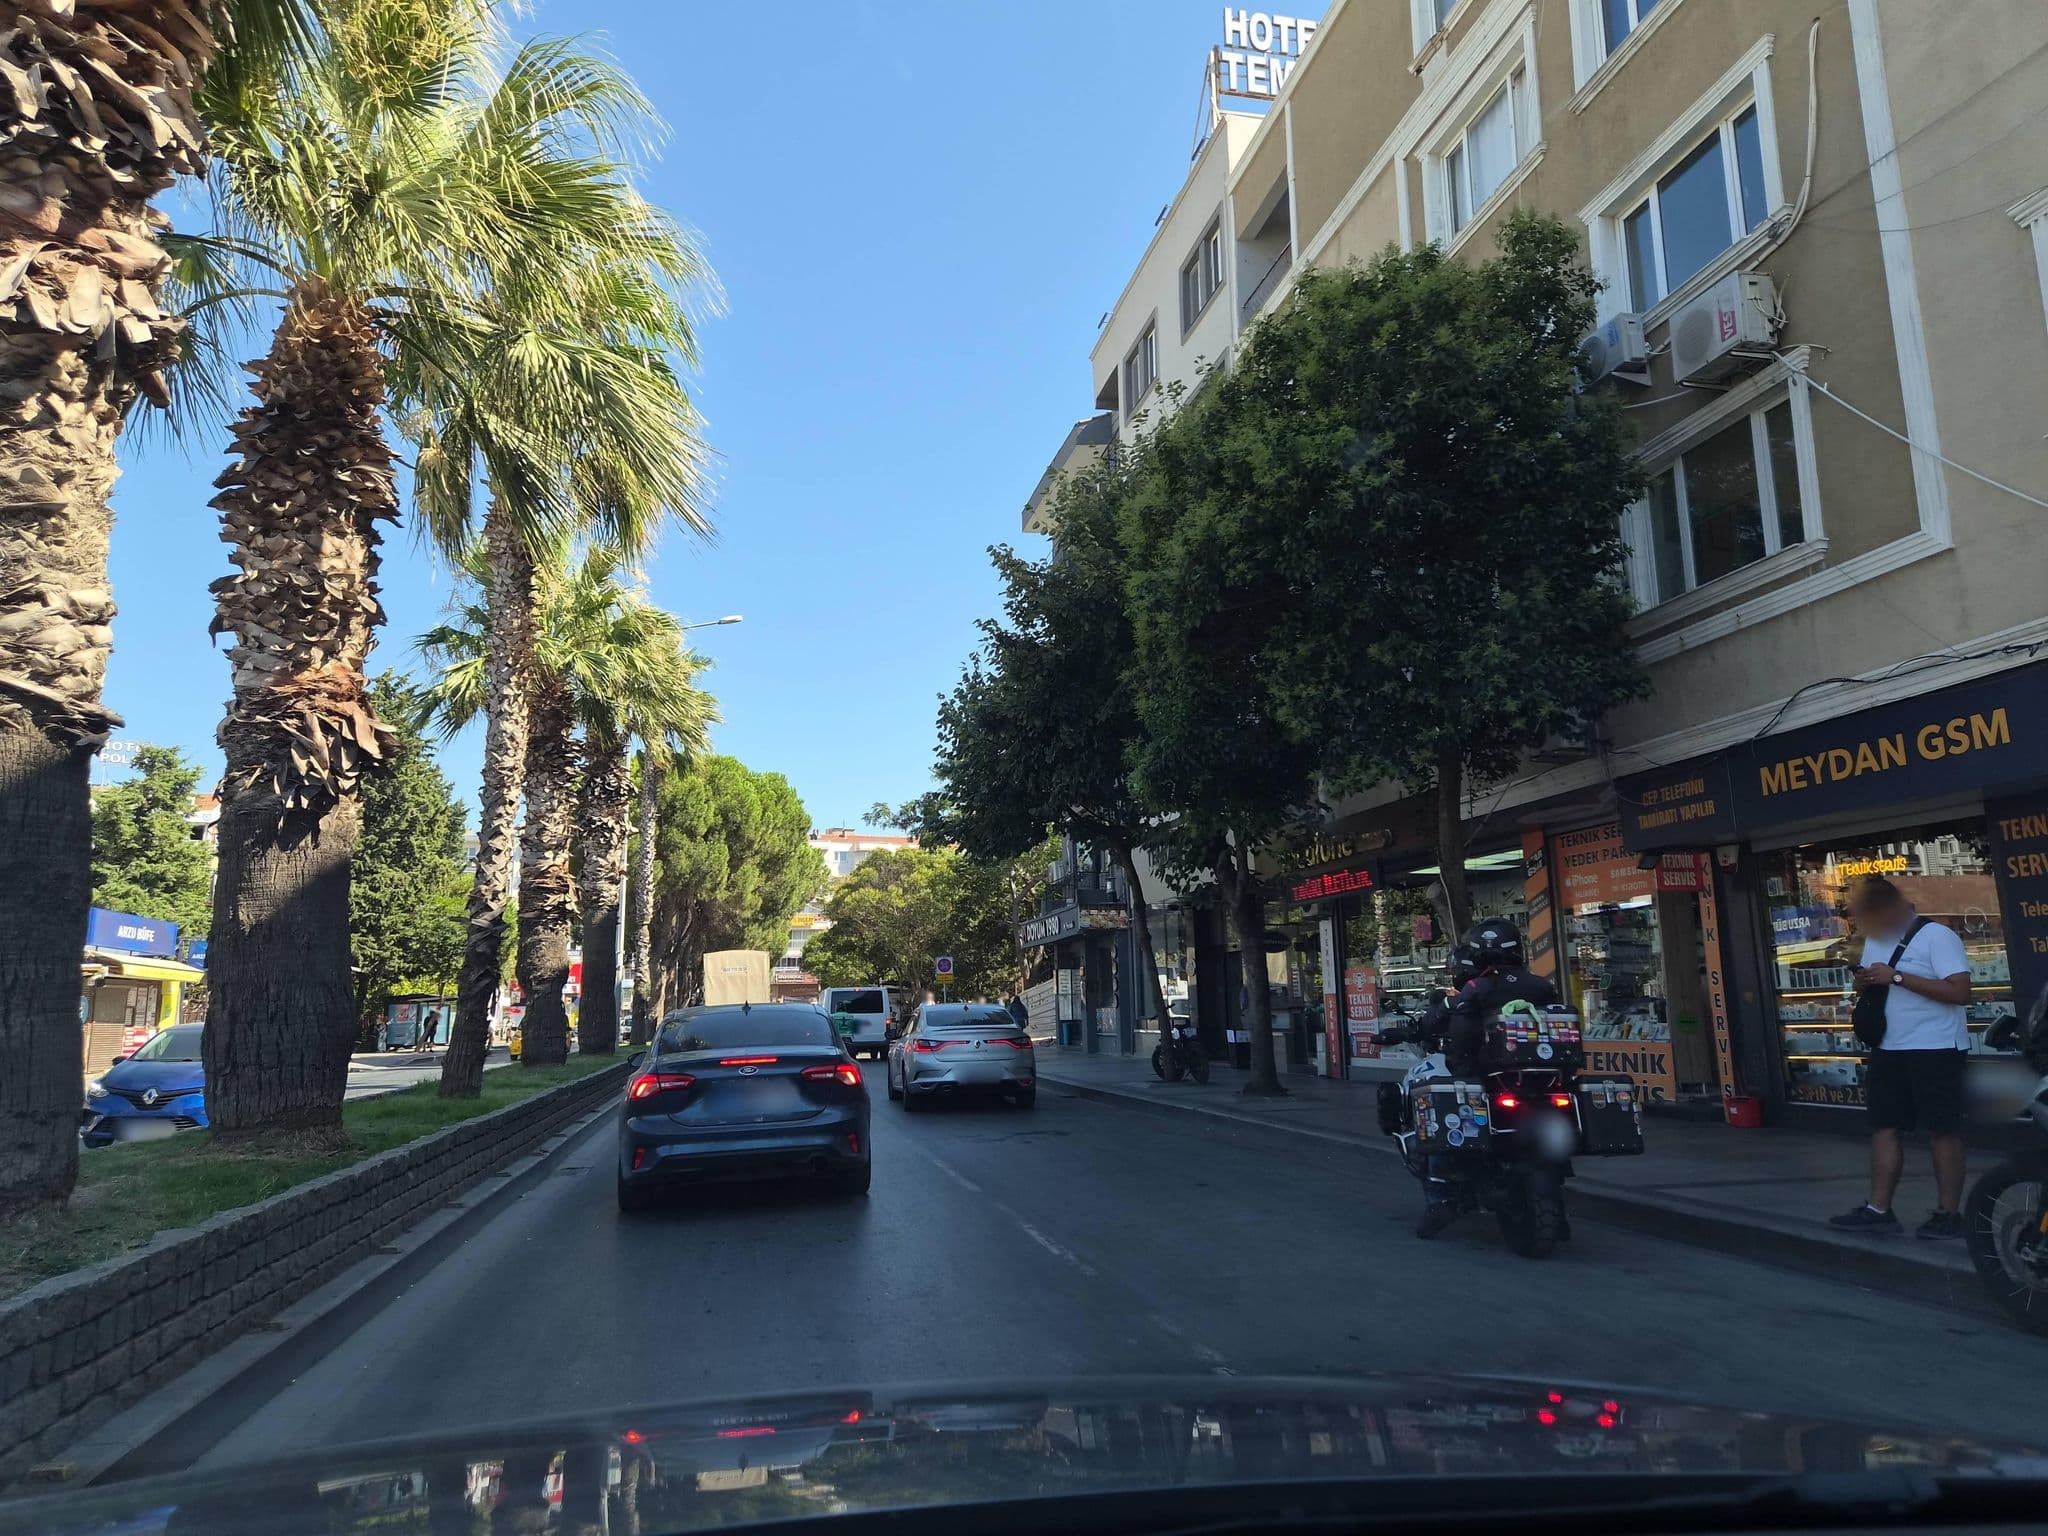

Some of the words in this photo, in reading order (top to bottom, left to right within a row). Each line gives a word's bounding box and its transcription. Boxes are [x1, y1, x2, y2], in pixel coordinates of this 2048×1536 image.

[1759, 732, 1908, 796] MEYDAN
[1916, 707, 2011, 761] GSM
[1660, 778, 1704, 801] TELEFONU
[1680, 799, 1716, 821] YAPILIR
[1563, 850, 1600, 868] YEDEK
[1662, 852, 1695, 869] TEKNİK
[1663, 870, 1697, 886] SERVİS
[1350, 1006, 1374, 1018] SERVİS
[1582, 1047, 1667, 1075] TEKNİK
